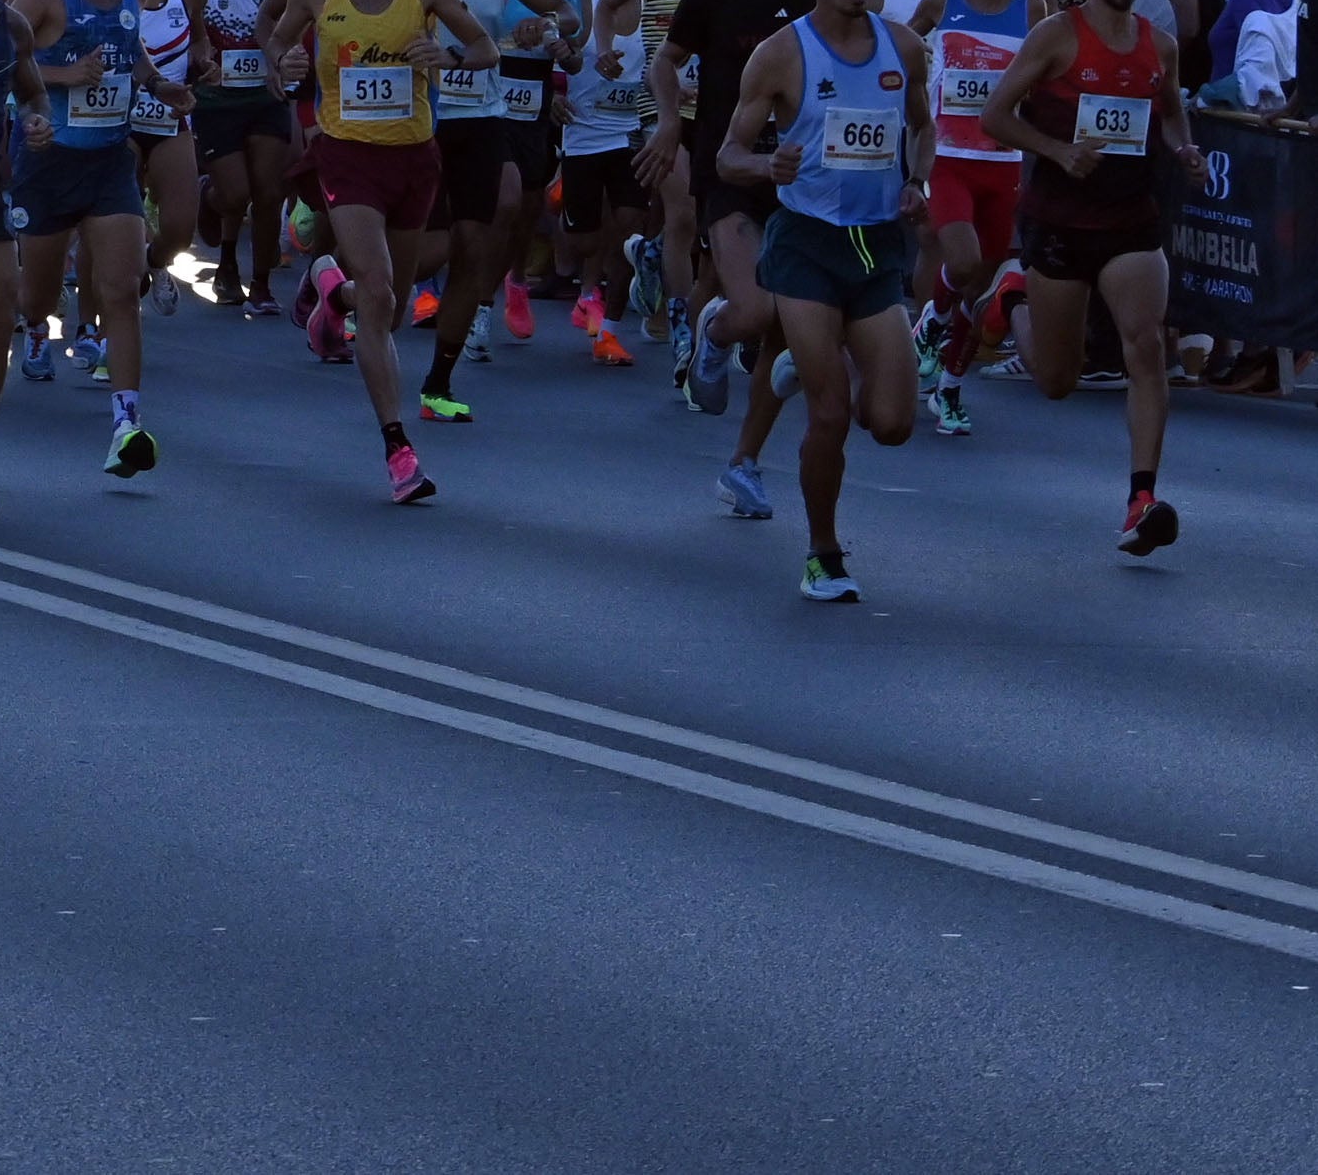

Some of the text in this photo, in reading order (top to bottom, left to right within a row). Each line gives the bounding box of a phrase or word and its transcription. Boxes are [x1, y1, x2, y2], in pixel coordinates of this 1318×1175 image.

[233, 58, 259, 74] 459
[443, 69, 474, 88] 444
[86, 87, 119, 107] 637
[356, 79, 392, 100] 513
[504, 88, 532, 106] 449
[608, 88, 635, 104] 436
[957, 80, 989, 98] 594
[136, 101, 165, 119] 529
[1096, 109, 1130, 132] 633
[844, 122, 885, 147] 666
[1171, 223, 1259, 277] MARBELLA
